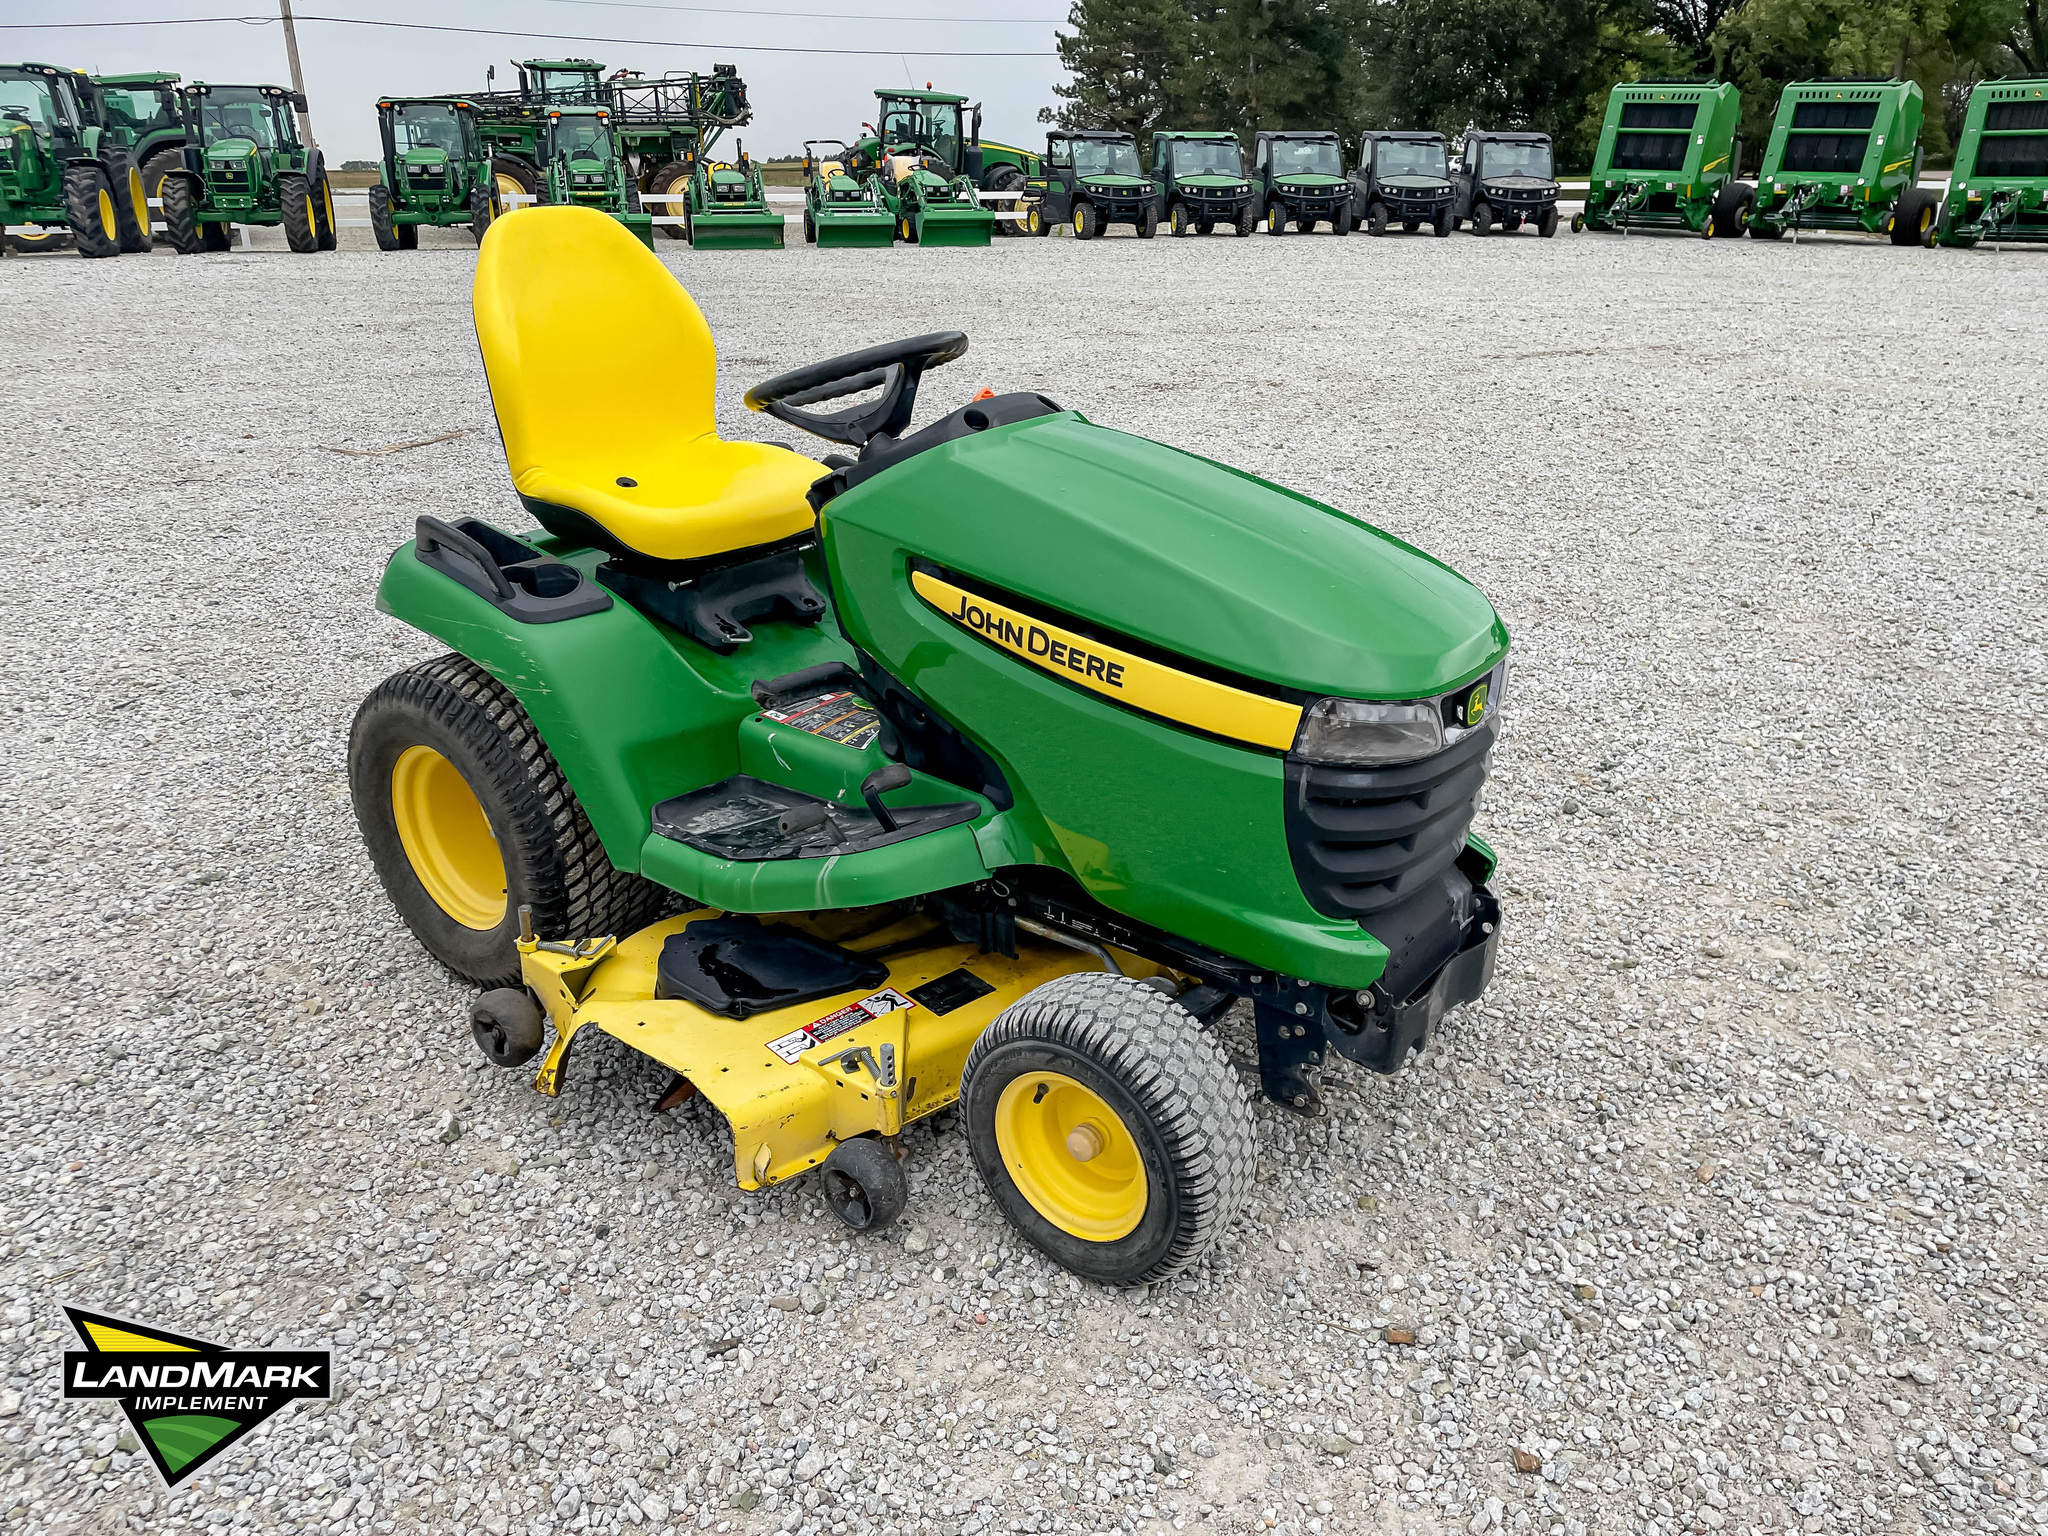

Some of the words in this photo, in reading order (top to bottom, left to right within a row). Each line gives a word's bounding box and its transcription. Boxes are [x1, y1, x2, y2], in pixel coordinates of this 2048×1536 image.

[951, 595, 1024, 649] JOHN
[1027, 625, 1126, 688] DEERE
[819, 1006, 853, 1025] DANGER
